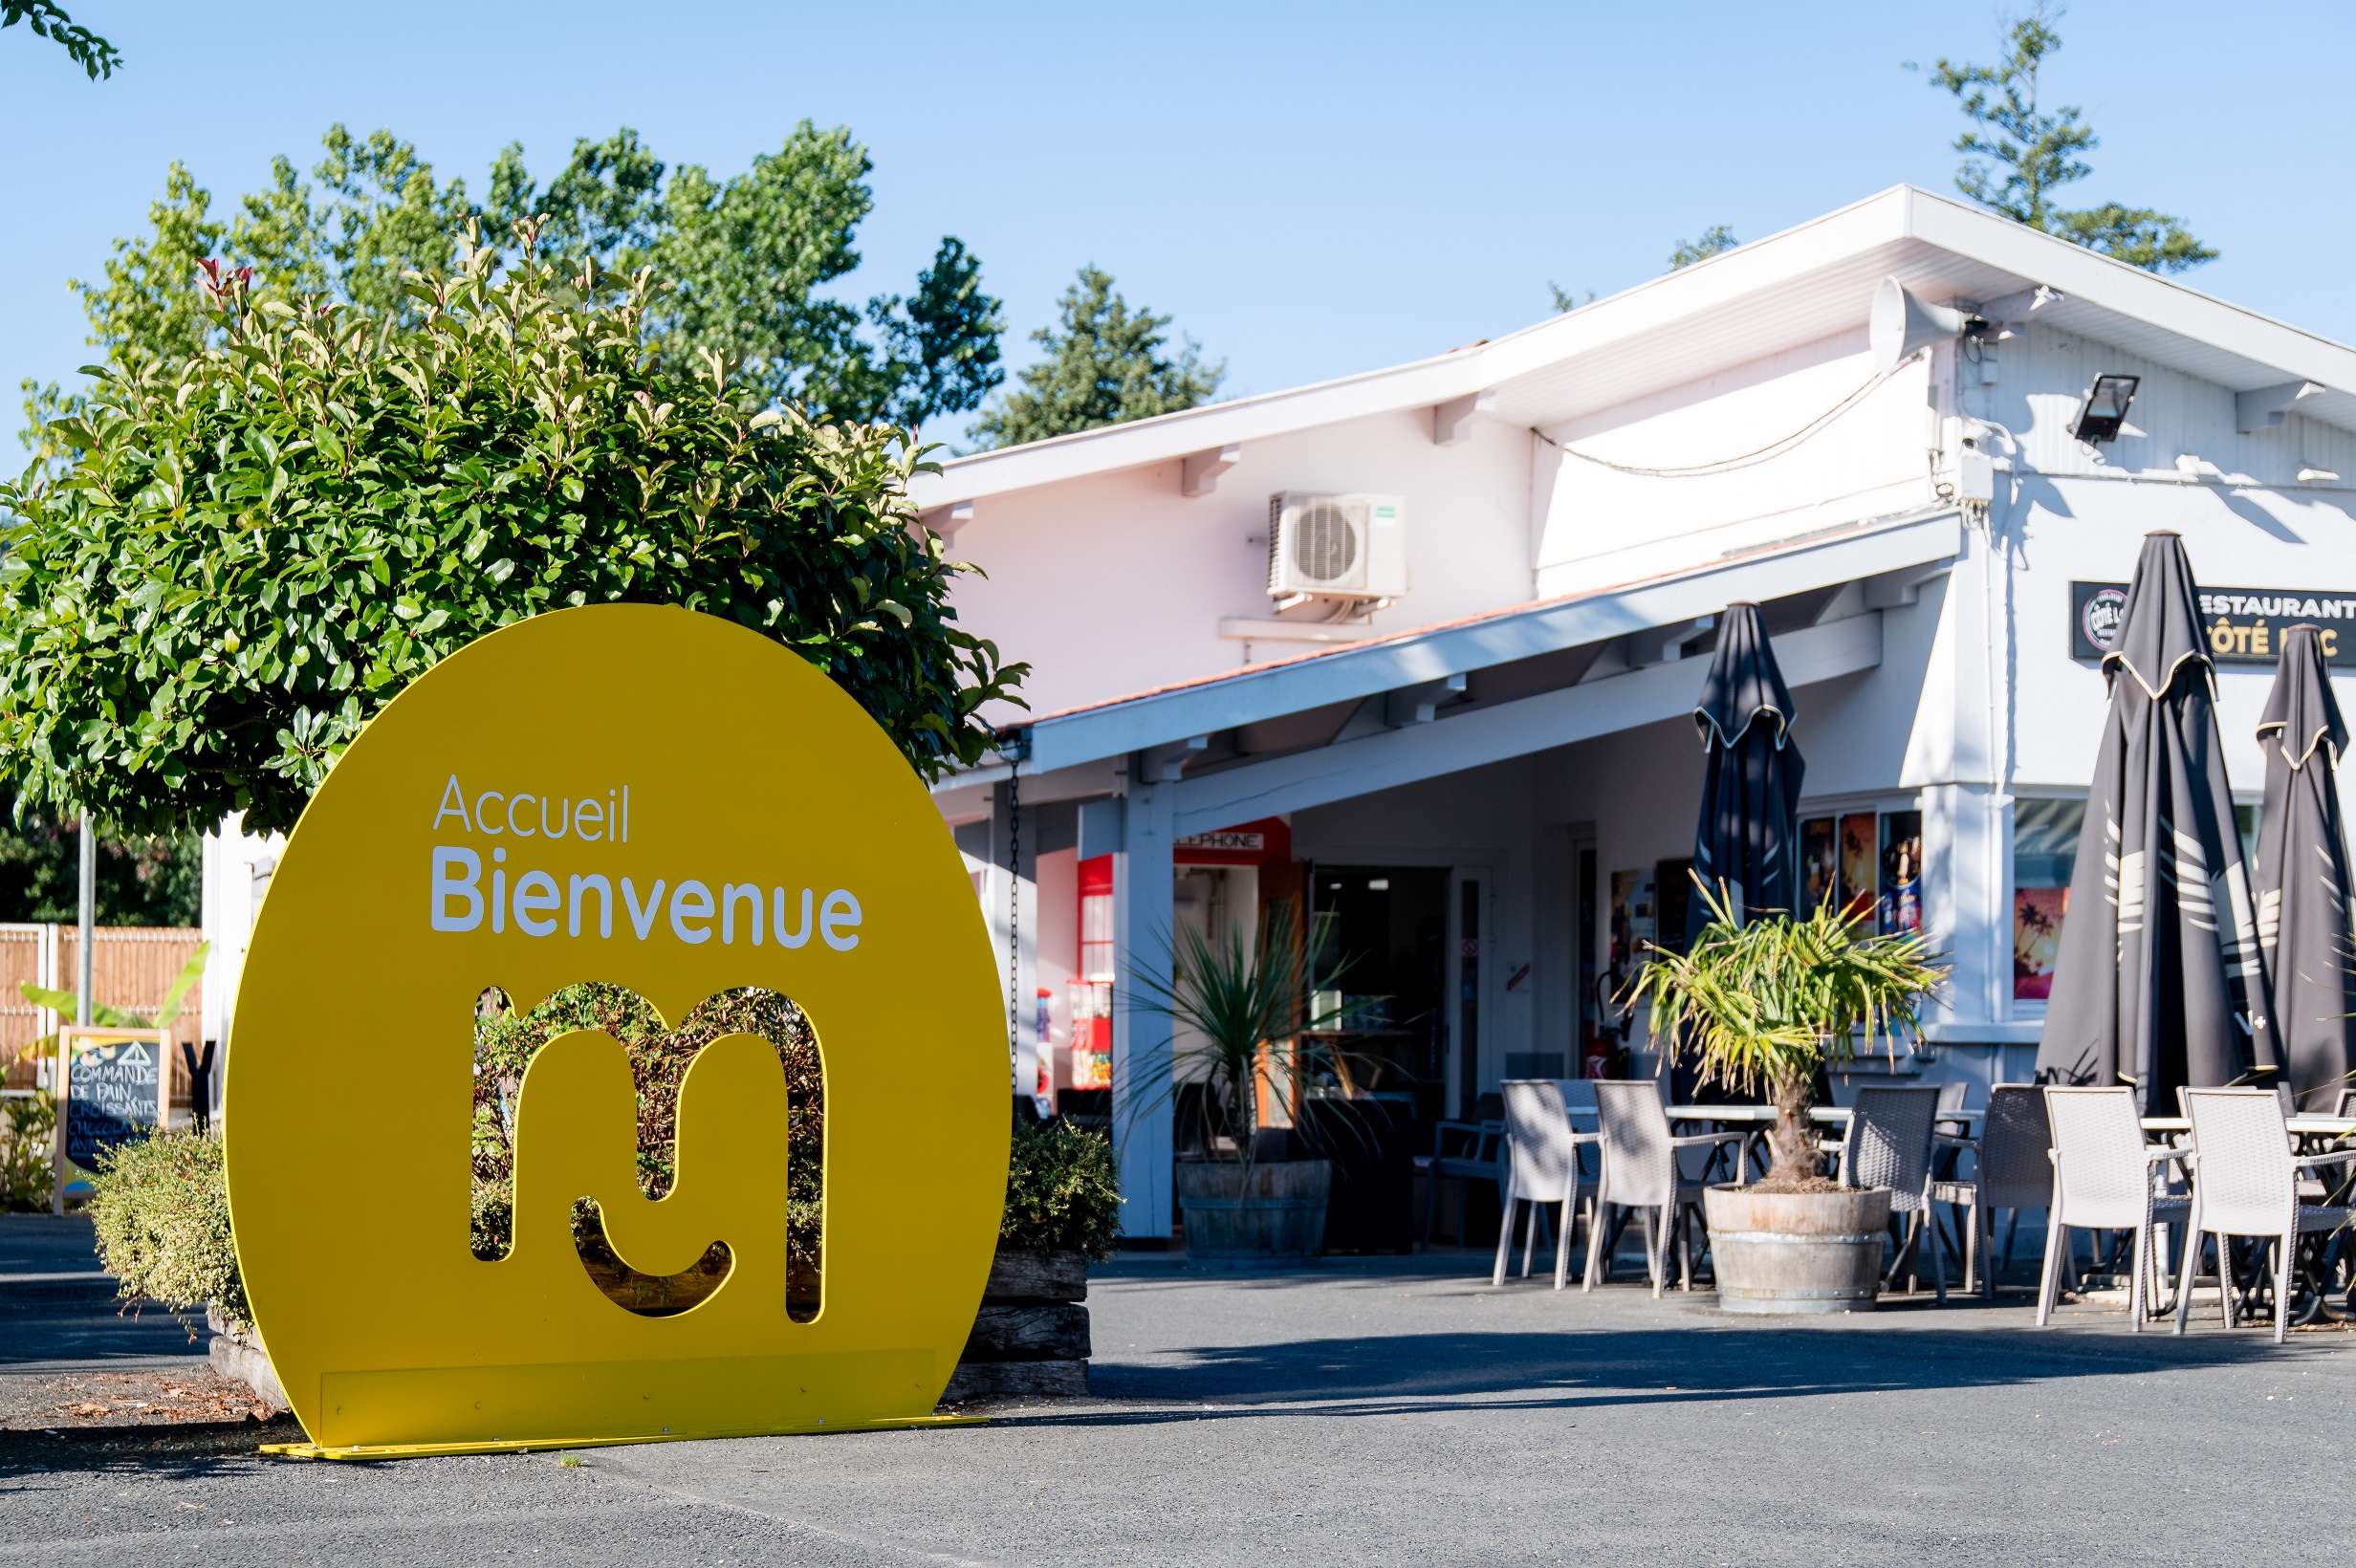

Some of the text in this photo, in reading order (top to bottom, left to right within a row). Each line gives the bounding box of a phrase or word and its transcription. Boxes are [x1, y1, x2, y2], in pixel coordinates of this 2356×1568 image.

[2199, 594, 2356, 620] ESTAURANT
[2206, 617, 2269, 655] ÔTÉ
[433, 773, 628, 843] Accueil
[1173, 833, 1259, 848] LEPHONE
[430, 845, 862, 951] Bienvenue
[70, 1063, 158, 1085] COMMANDE
[70, 1084, 90, 1101] DE
